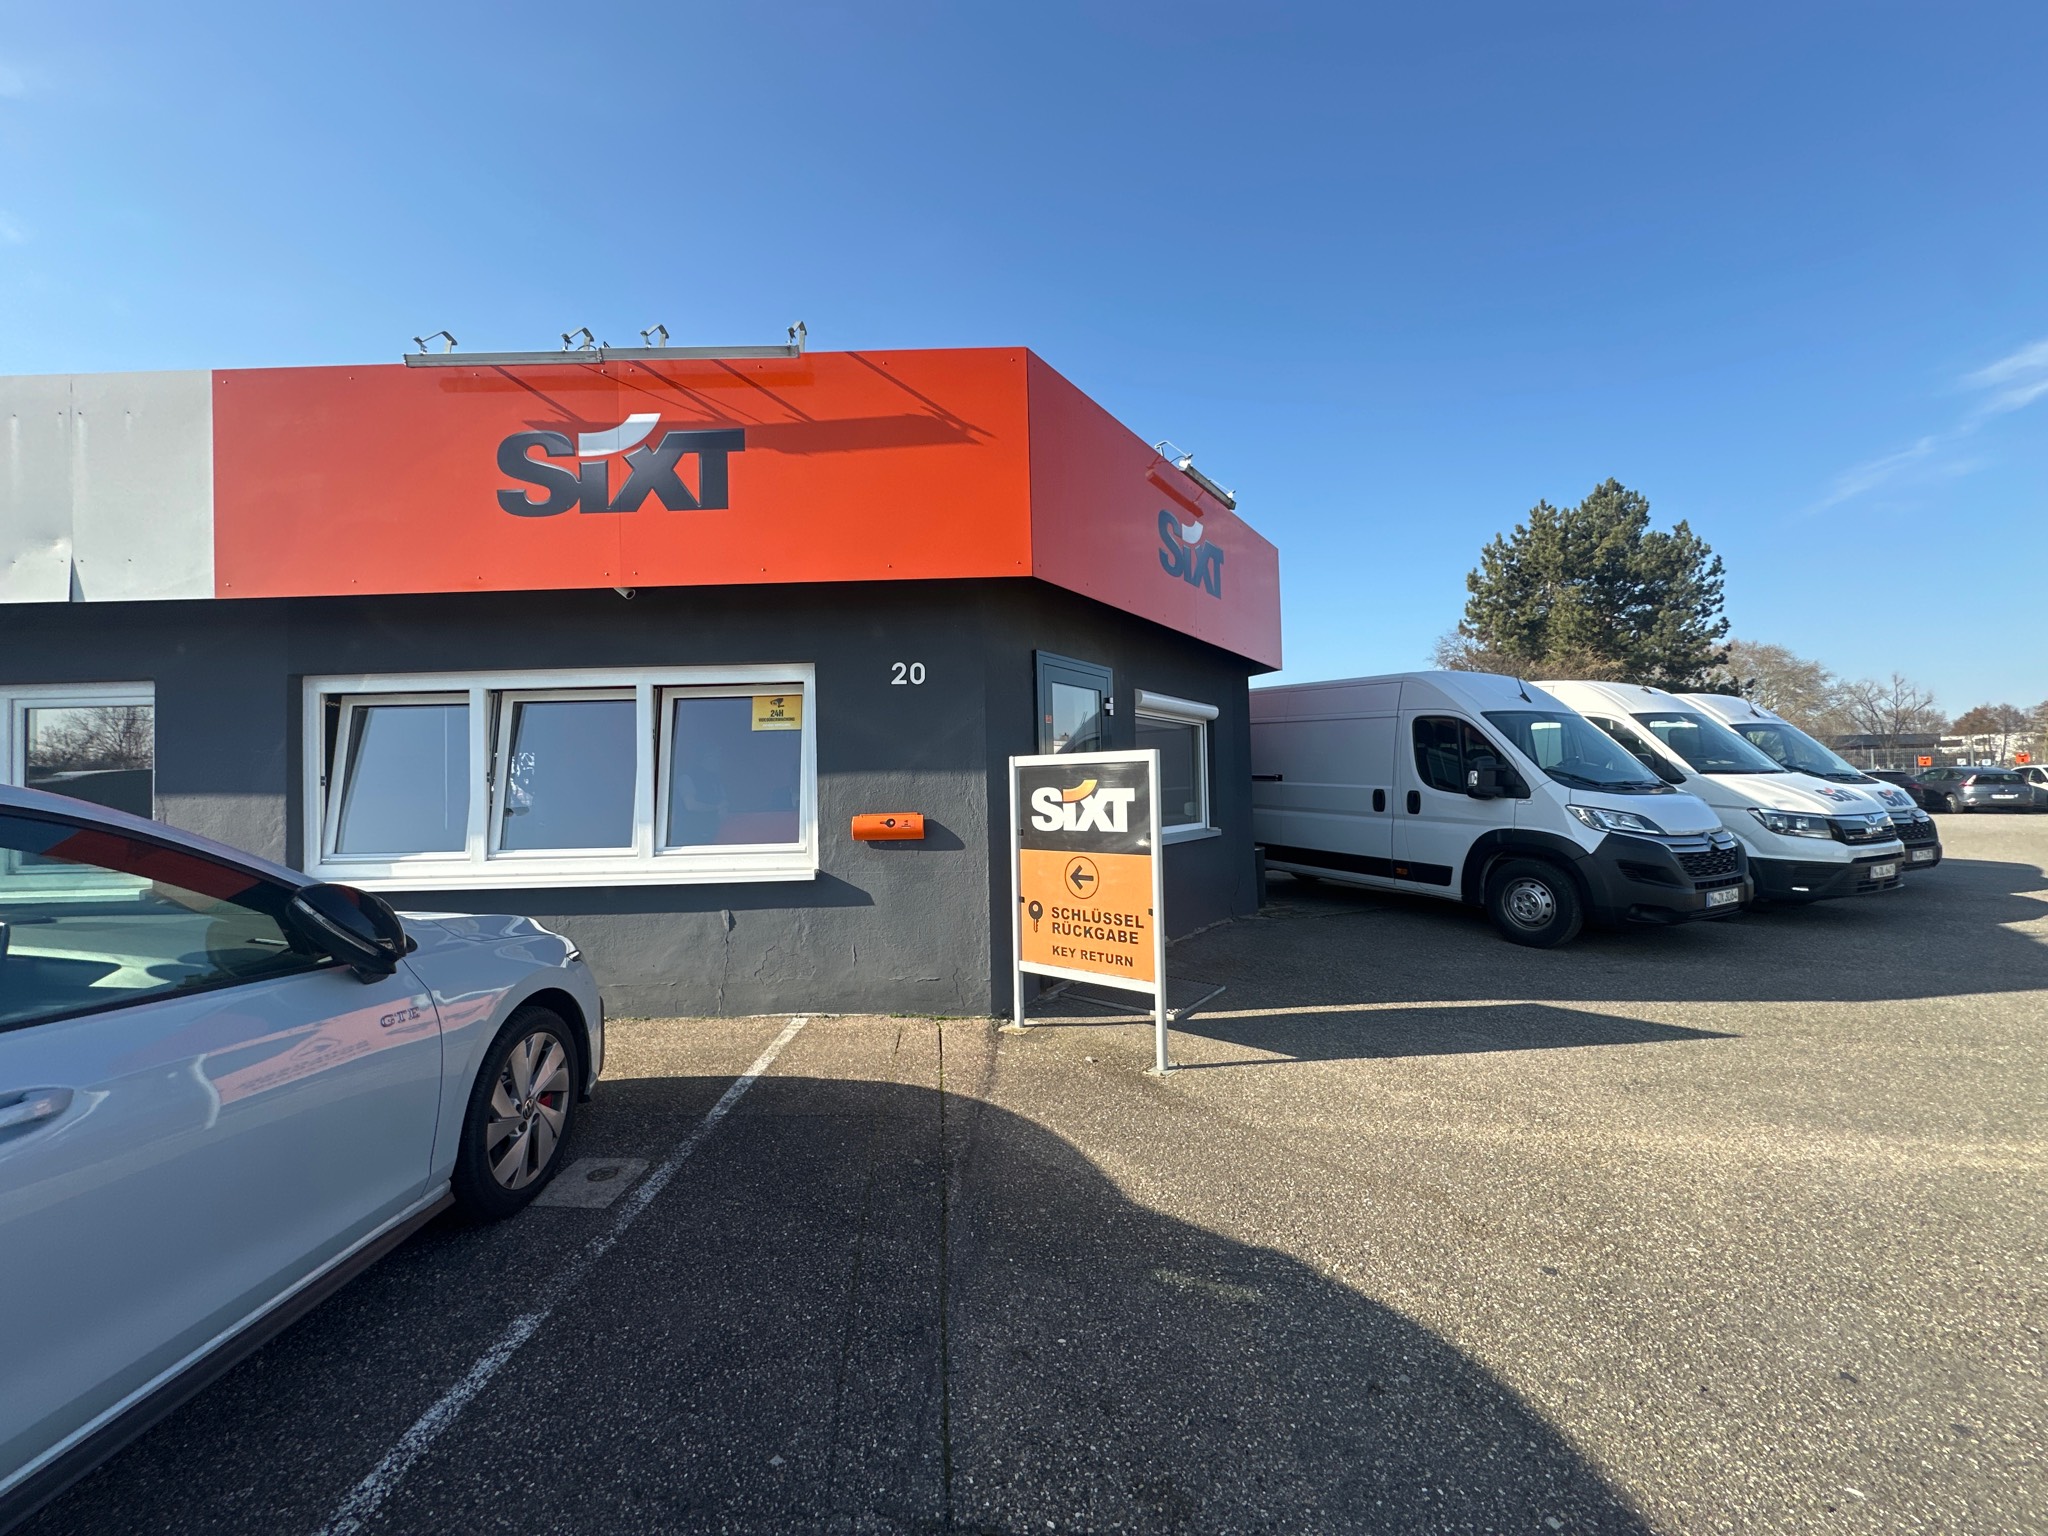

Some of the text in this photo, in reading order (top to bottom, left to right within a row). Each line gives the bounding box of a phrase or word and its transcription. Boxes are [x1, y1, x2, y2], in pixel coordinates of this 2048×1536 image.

[891, 662, 926, 685] 20
[770, 709, 784, 717] 24H
[1051, 907, 1144, 929] SCHLÜSSEL
[1052, 921, 1139, 945] RÜCKGABE
[1052, 945, 1134, 967] KEY RETURN
[380, 1006, 421, 1028] GTE
